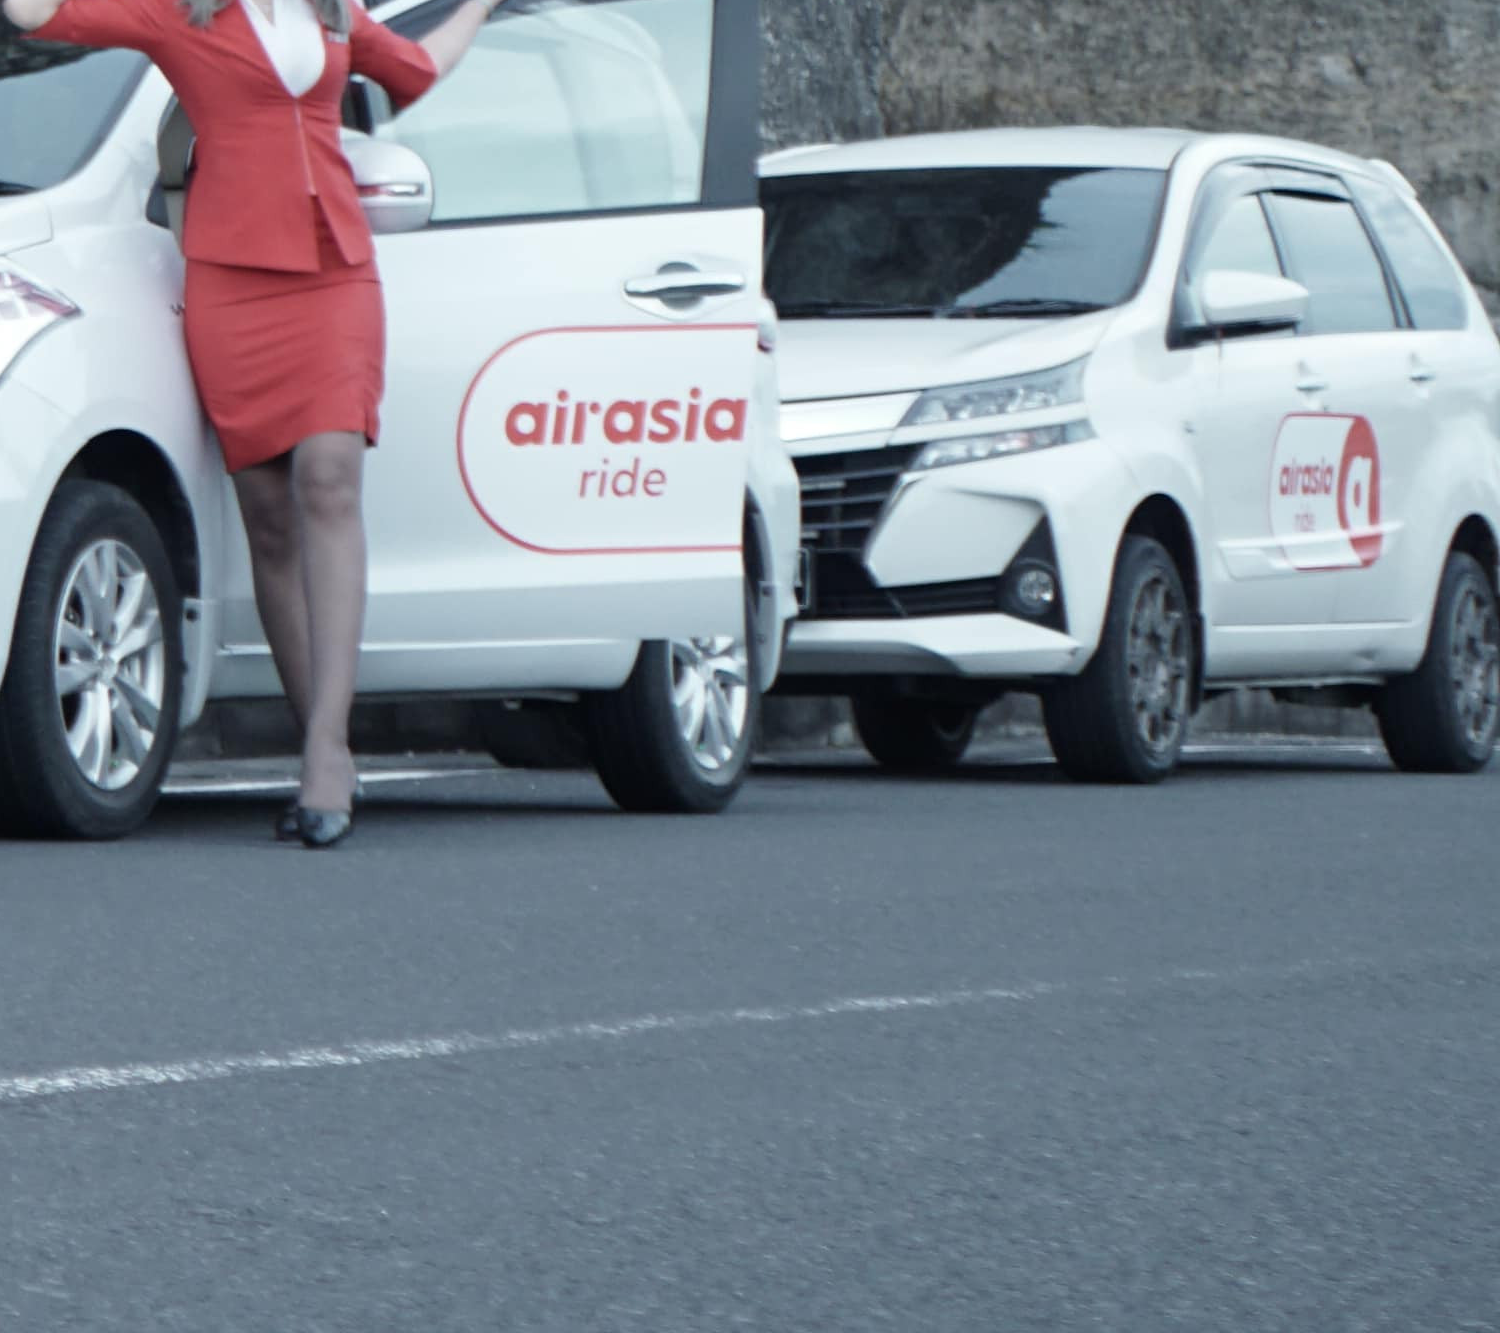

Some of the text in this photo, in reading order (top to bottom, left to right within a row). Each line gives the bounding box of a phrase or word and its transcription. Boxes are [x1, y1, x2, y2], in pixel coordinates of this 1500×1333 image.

[504, 387, 748, 446] airasia
[578, 457, 667, 498] ride
[1279, 456, 1333, 496] airasia
